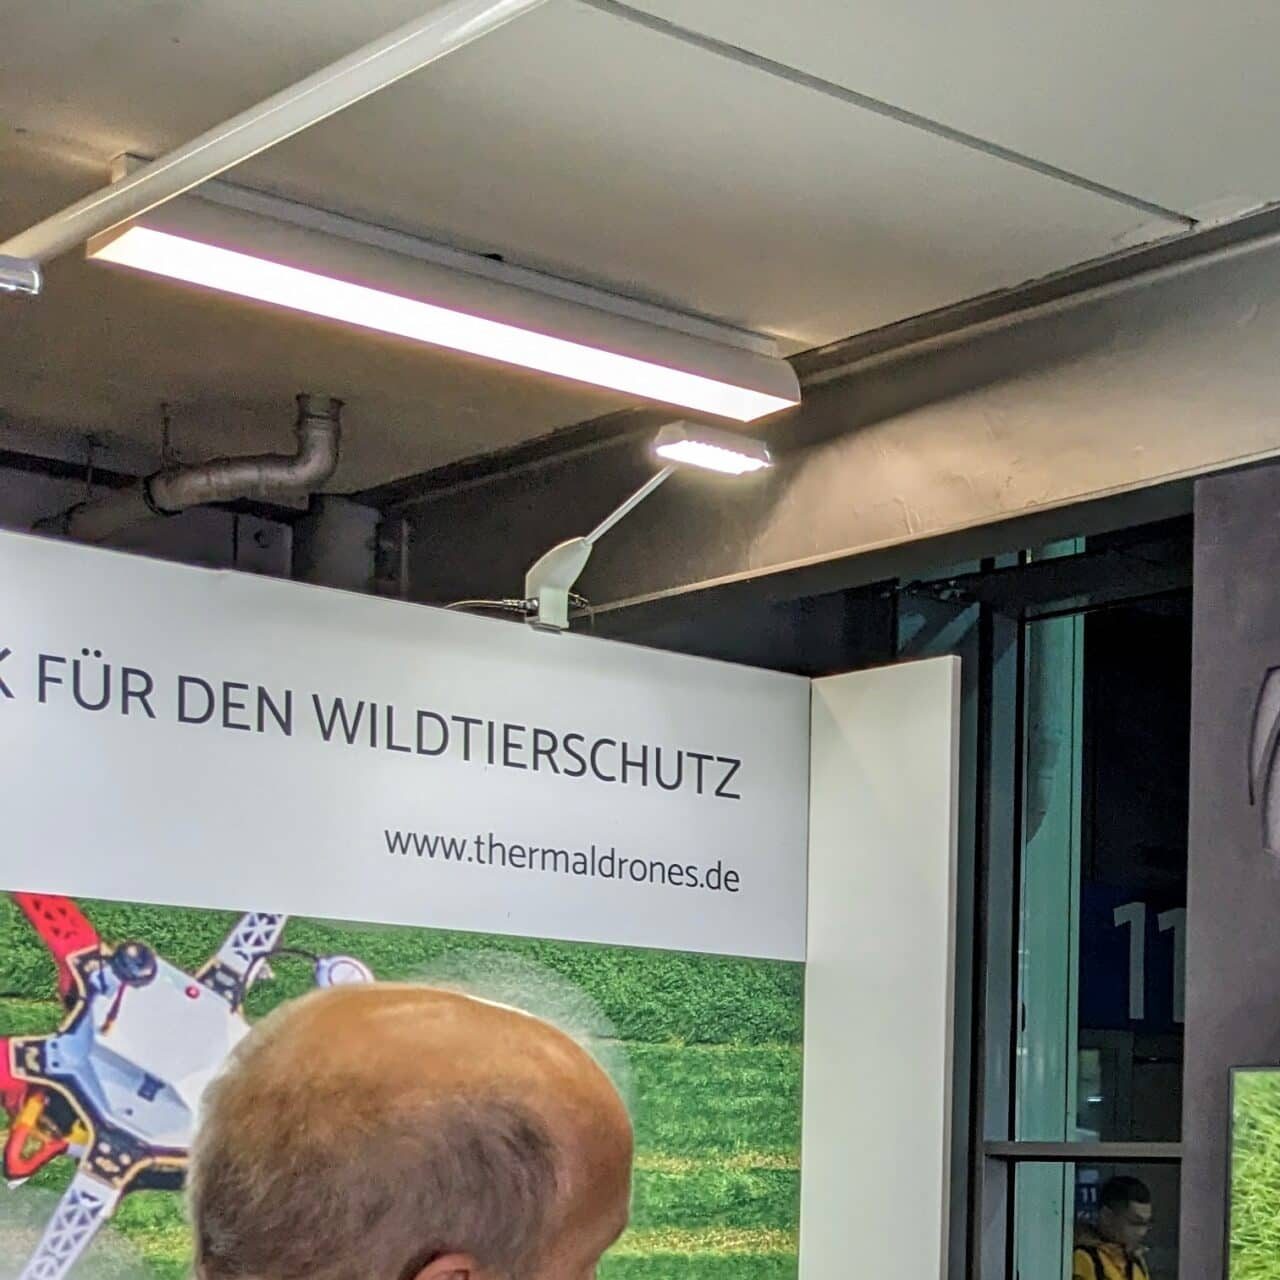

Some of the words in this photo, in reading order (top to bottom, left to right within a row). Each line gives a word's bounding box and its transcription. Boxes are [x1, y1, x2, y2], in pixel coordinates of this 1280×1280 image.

[38, 647, 156, 719] FÜR
[177, 674, 292, 737] DEN
[312, 693, 742, 800] WILDTIERSCHUTZ
[384, 829, 741, 893] www.thermaldrones.de
[1112, 901, 1188, 1024] 11
